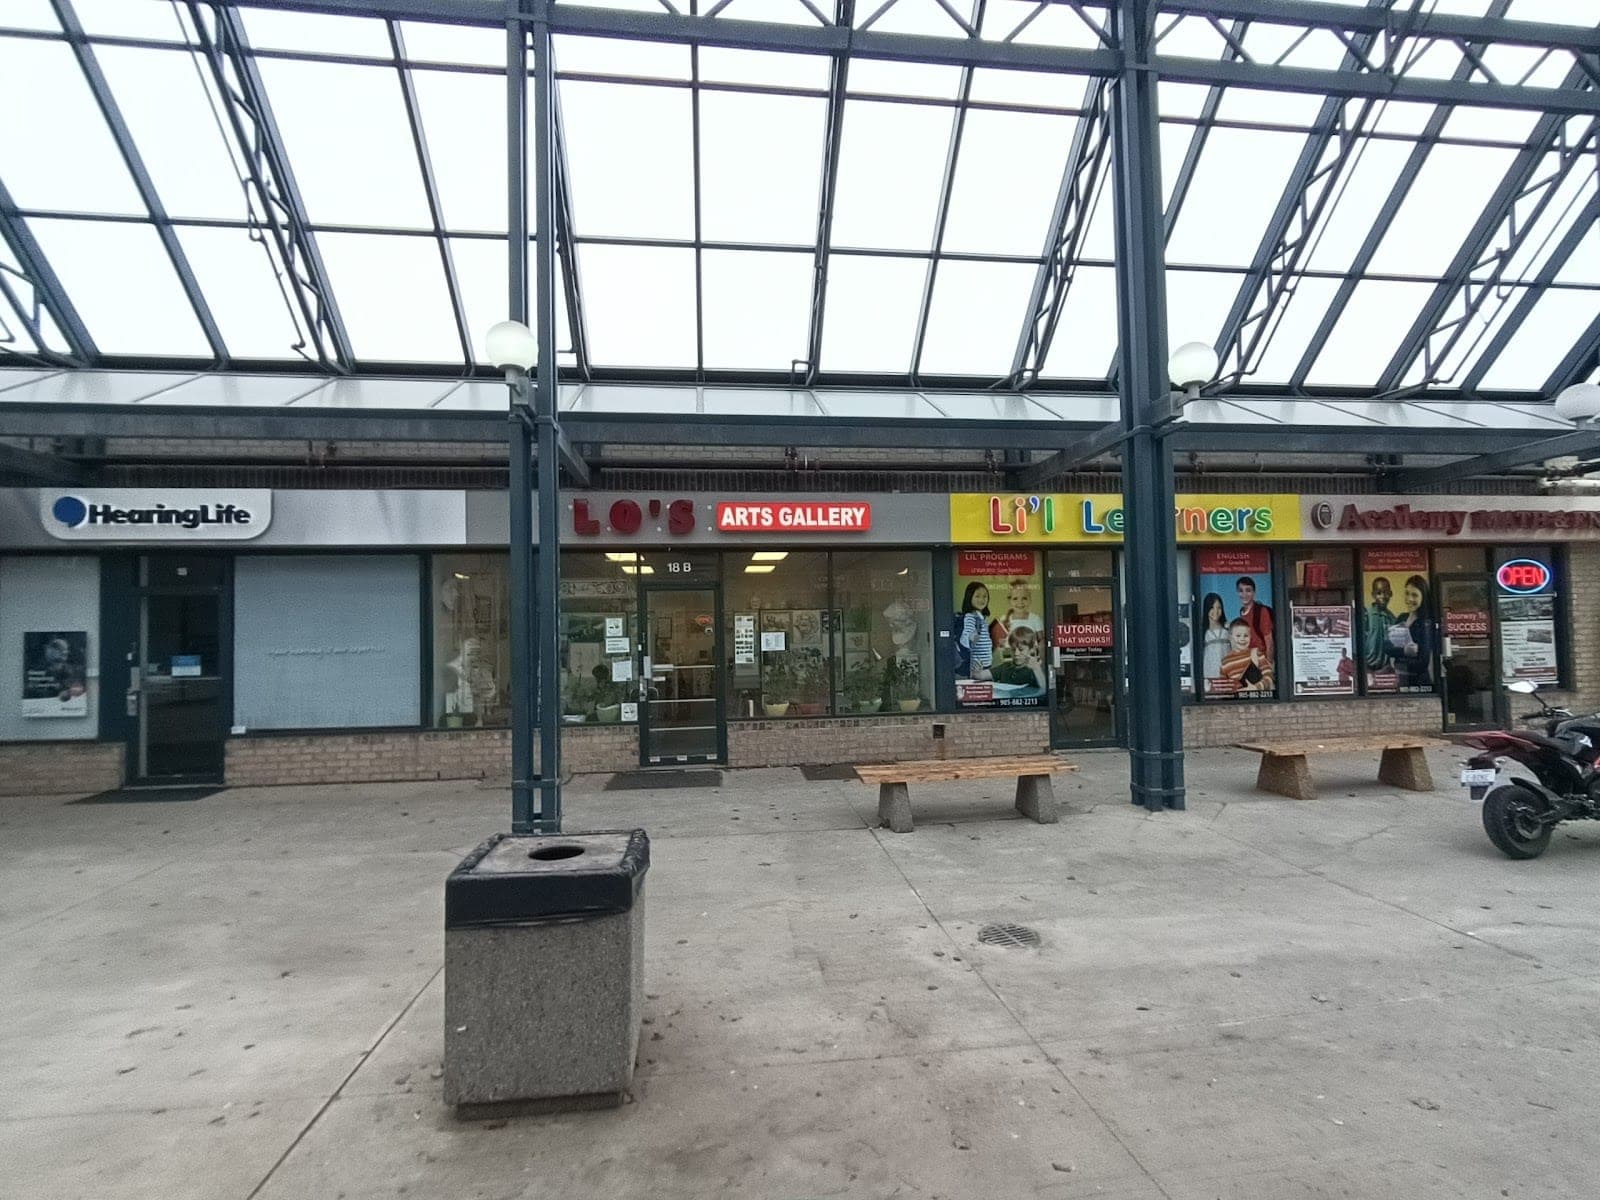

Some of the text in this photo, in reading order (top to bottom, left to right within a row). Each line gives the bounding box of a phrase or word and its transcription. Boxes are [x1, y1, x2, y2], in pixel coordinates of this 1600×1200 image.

[88, 504, 250, 528] HearingLife
[573, 498, 696, 535] LO'S
[721, 506, 867, 527] ARTS GALLERY
[1082, 499, 1274, 533] Leners
[1338, 503, 1469, 536] Academy
[667, 562, 692, 573] 18 B
[1500, 566, 1544, 586] OPEN
[1057, 624, 1111, 634] TUTORING
[1447, 622, 1487, 632] SUCCESS
[1079, 636, 1111, 644] WORKS!!
